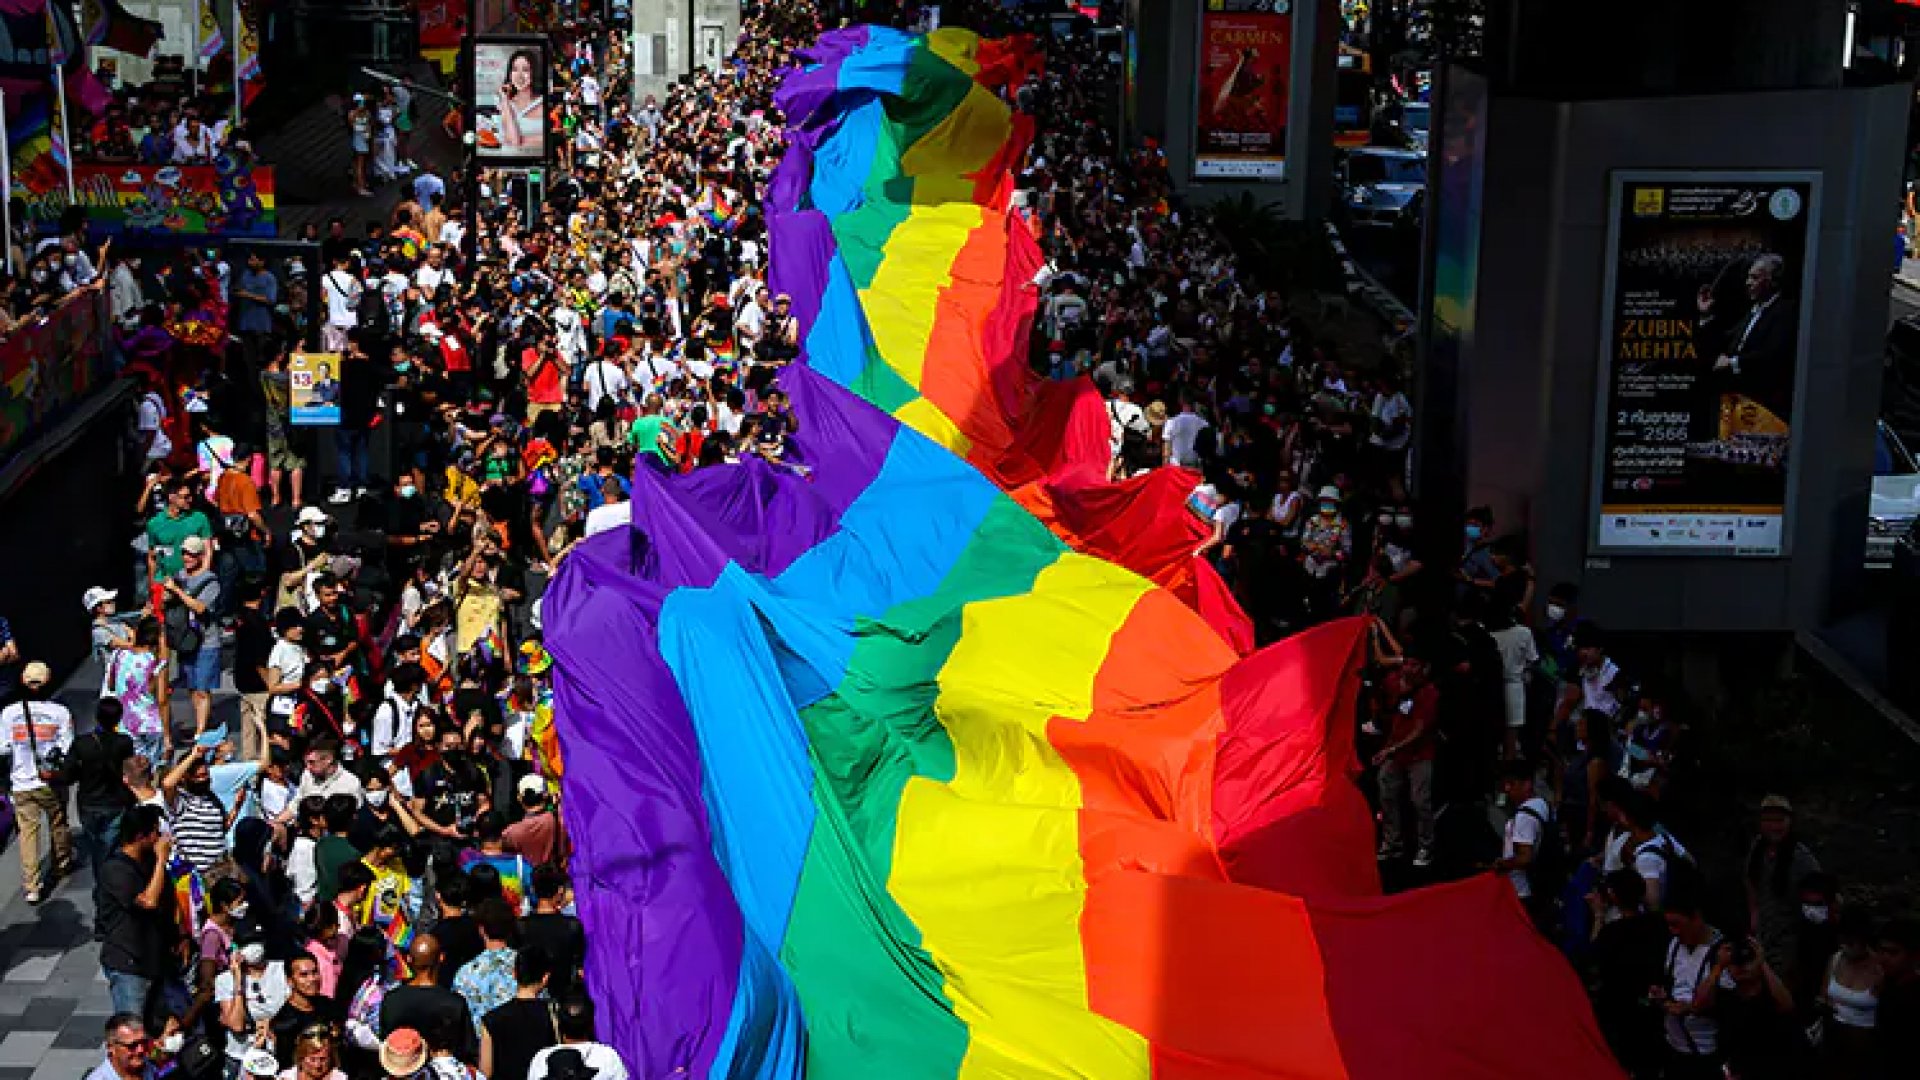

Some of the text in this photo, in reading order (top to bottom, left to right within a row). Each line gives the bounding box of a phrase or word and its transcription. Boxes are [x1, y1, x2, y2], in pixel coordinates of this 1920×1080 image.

[1210, 30, 1284, 45] CARMEN
[1620, 319, 1693, 338] ZUBIN
[1618, 340, 1698, 359] MEHTA
[1643, 427, 1687, 441] 2566
